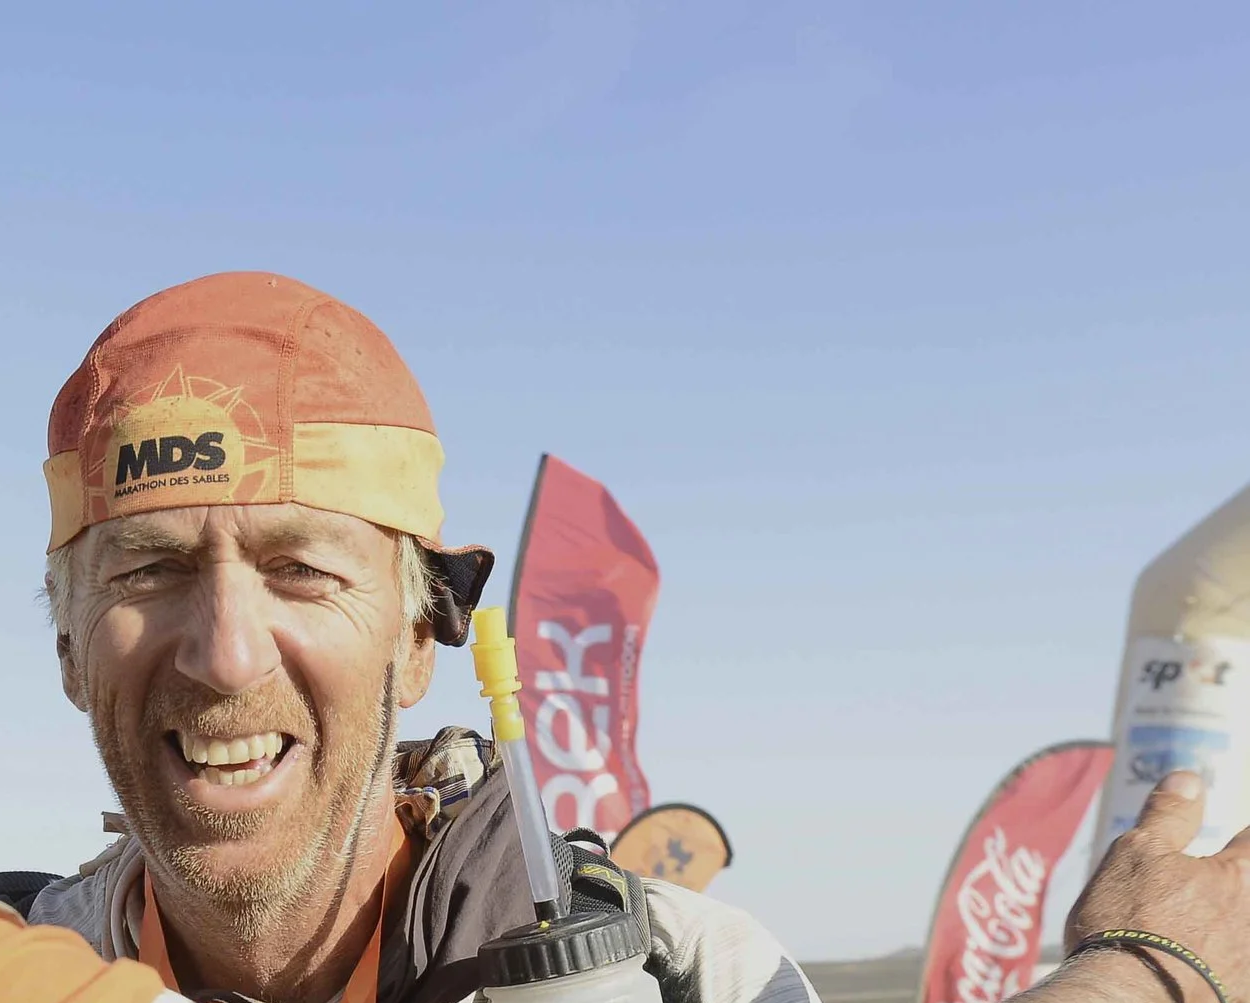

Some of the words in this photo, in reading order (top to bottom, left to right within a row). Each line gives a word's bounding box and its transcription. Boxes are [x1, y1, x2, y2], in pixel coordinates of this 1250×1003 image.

[115, 432, 226, 485] MDS
[114, 478, 168, 498] MARATHON
[170, 476, 189, 486] DES
[192, 473, 230, 484] SABLES
